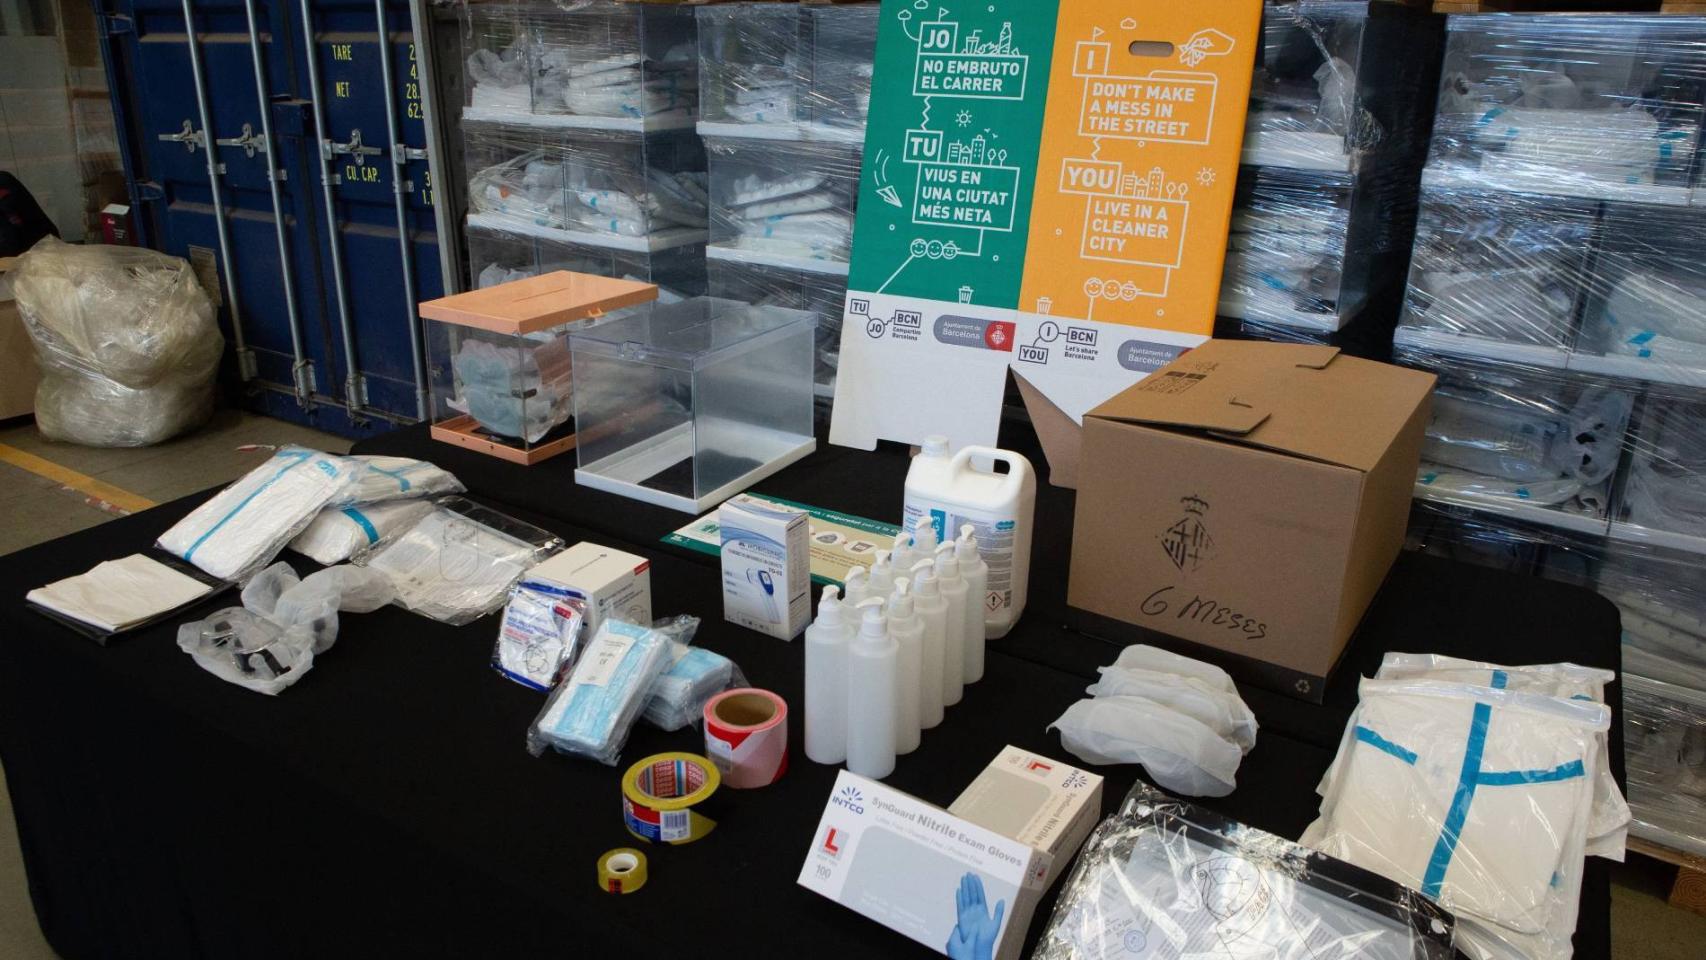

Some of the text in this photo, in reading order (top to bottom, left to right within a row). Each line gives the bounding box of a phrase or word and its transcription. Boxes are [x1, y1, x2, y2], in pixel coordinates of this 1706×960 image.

[923, 29, 950, 49] JO
[332, 44, 352, 61] TARE
[1087, 50, 1095, 70] I
[923, 60, 1020, 76] NO EMBRUTO
[336, 82, 350, 98] NET
[921, 76, 1003, 92] EL CARRER
[1092, 82, 1196, 102] DON'T MAKE
[1090, 100, 1173, 118] A MESS IN
[1088, 116, 1189, 136] THE STREET
[910, 137, 938, 157] TU
[346, 165, 381, 183] CU. CAP.
[924, 168, 981, 185] VIUS EN
[1067, 166, 1115, 189] YOU
[922, 186, 1009, 206] UNA CIUTAT
[920, 201, 992, 224] MÉS NETA
[1094, 200, 1168, 220] LIVE IN A
[1092, 218, 1168, 239] CLEANER
[1089, 236, 1127, 252] CITY
[852, 302, 867, 312] TU
[869, 323, 882, 333] JO
[897, 313, 919, 325] BCN
[942, 328, 981, 340] Barcelona
[1046, 326, 1051, 337] I
[1070, 332, 1095, 343] BCN
[1022, 349, 1045, 361] YOU
[1140, 586, 1267, 640] 6 MESES
[832, 796, 864, 815] INTCO
[825, 827, 839, 853] L
[871, 797, 1023, 867] SynGuard Nitrile Exam Gloves
[816, 864, 832, 879] 100
